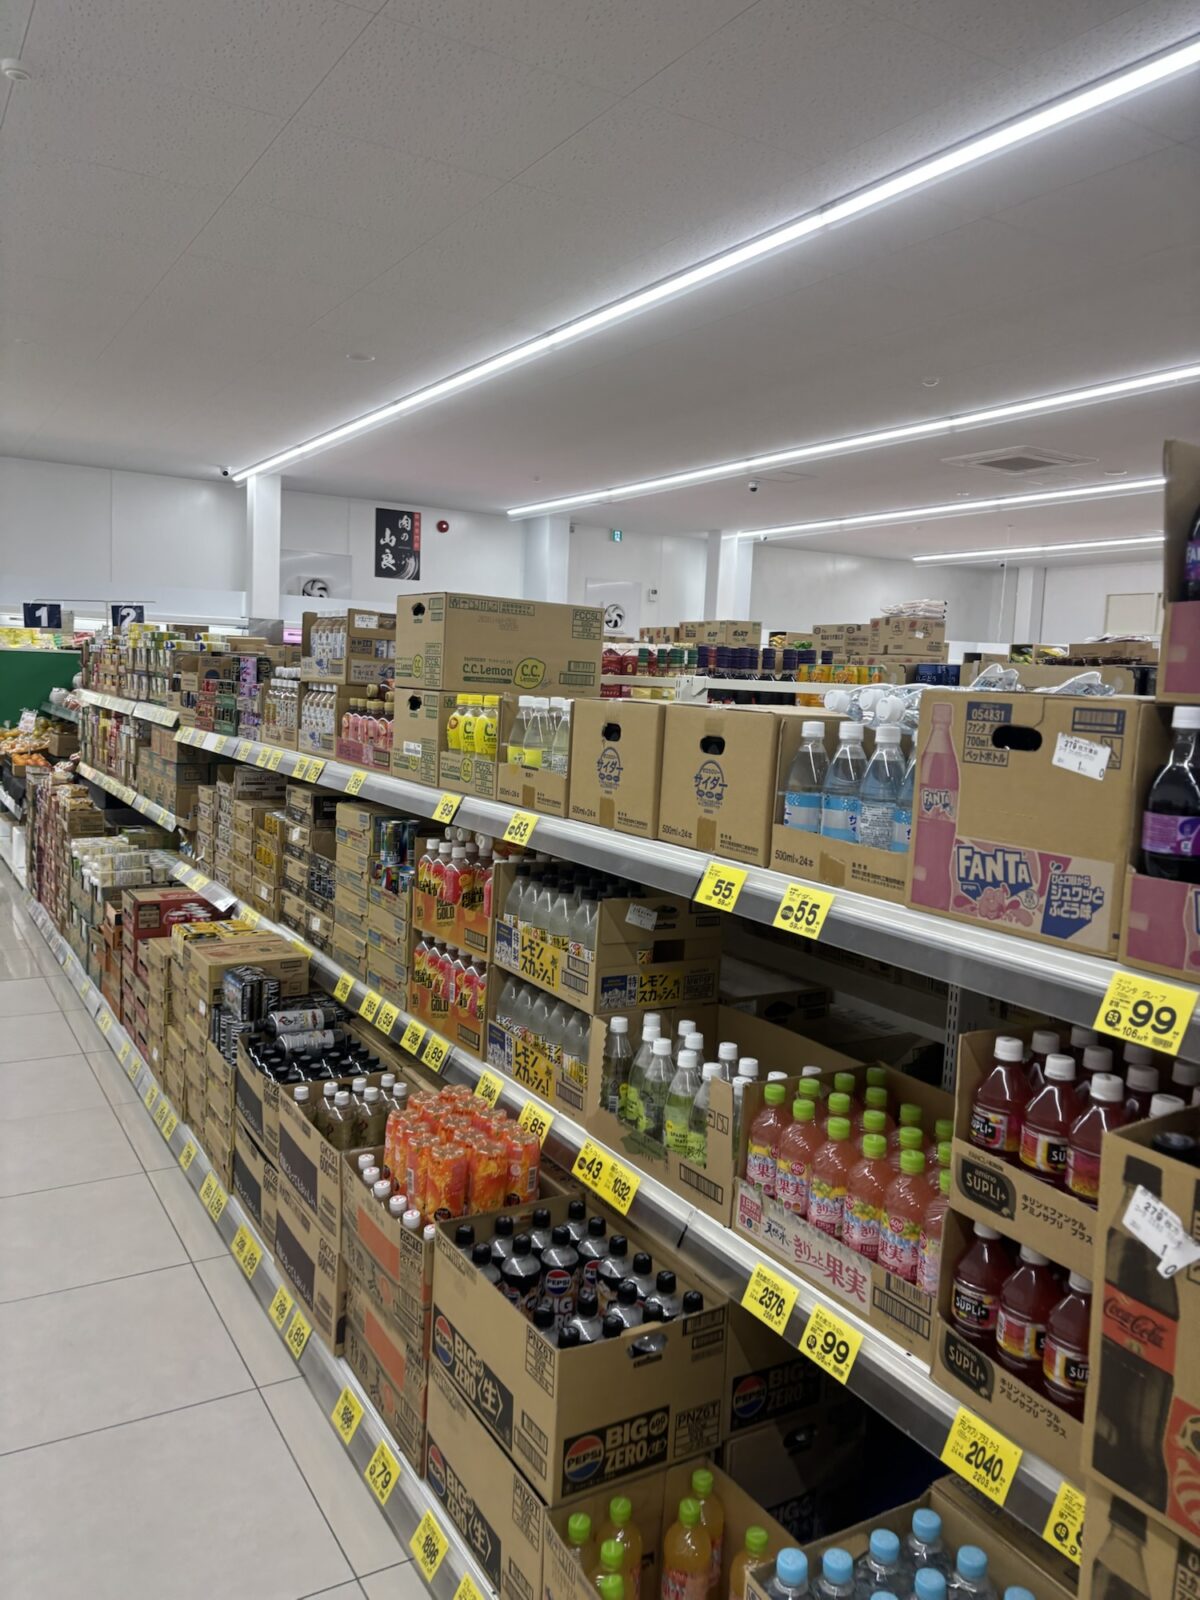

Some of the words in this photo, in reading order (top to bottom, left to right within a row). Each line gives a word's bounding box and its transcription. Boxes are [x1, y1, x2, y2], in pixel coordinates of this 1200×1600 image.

[399, 515, 411, 541] 肉の
[35, 606, 49, 627] 1
[120, 607, 137, 636] 2
[463, 663, 513, 677] C.C.Lemon
[521, 664, 540, 678] C.C.
[597, 759, 623, 774] サイダー
[694, 774, 728, 790] サイダー
[441, 803, 454, 817] 99
[923, 790, 950, 806] FANTA
[515, 821, 529, 838] 63
[959, 847, 1031, 885] FANTA
[712, 879, 735, 900] 55
[1051, 886, 1105, 906] ジュワッと
[794, 900, 820, 926] 55
[521, 935, 544, 960] レモン
[640, 974, 668, 988] レモン
[1128, 1000, 1177, 1035] 99
[515, 1040, 539, 1068] レモン
[529, 1117, 546, 1138] 85
[586, 1157, 603, 1180] 43
[612, 1176, 631, 1202] 1032
[779, 1179, 805, 1198] 果実
[966, 1172, 1007, 1202] SUPLI+
[764, 1221, 789, 1246] 天然水
[547, 1278, 570, 1288] PEPSI
[758, 1286, 786, 1317] 2376
[956, 1296, 986, 1316] SUPLI+
[454, 1332, 476, 1374] BIG
[820, 1330, 850, 1365] 99
[948, 1345, 985, 1380] SUPLI+
[454, 1356, 477, 1401] ZERO
[605, 1417, 649, 1449] BIG
[567, 1449, 602, 1468] PEPSI
[604, 1439, 648, 1474] ZERO
[964, 1440, 1004, 1482] 2040
[376, 1461, 392, 1490] 79
